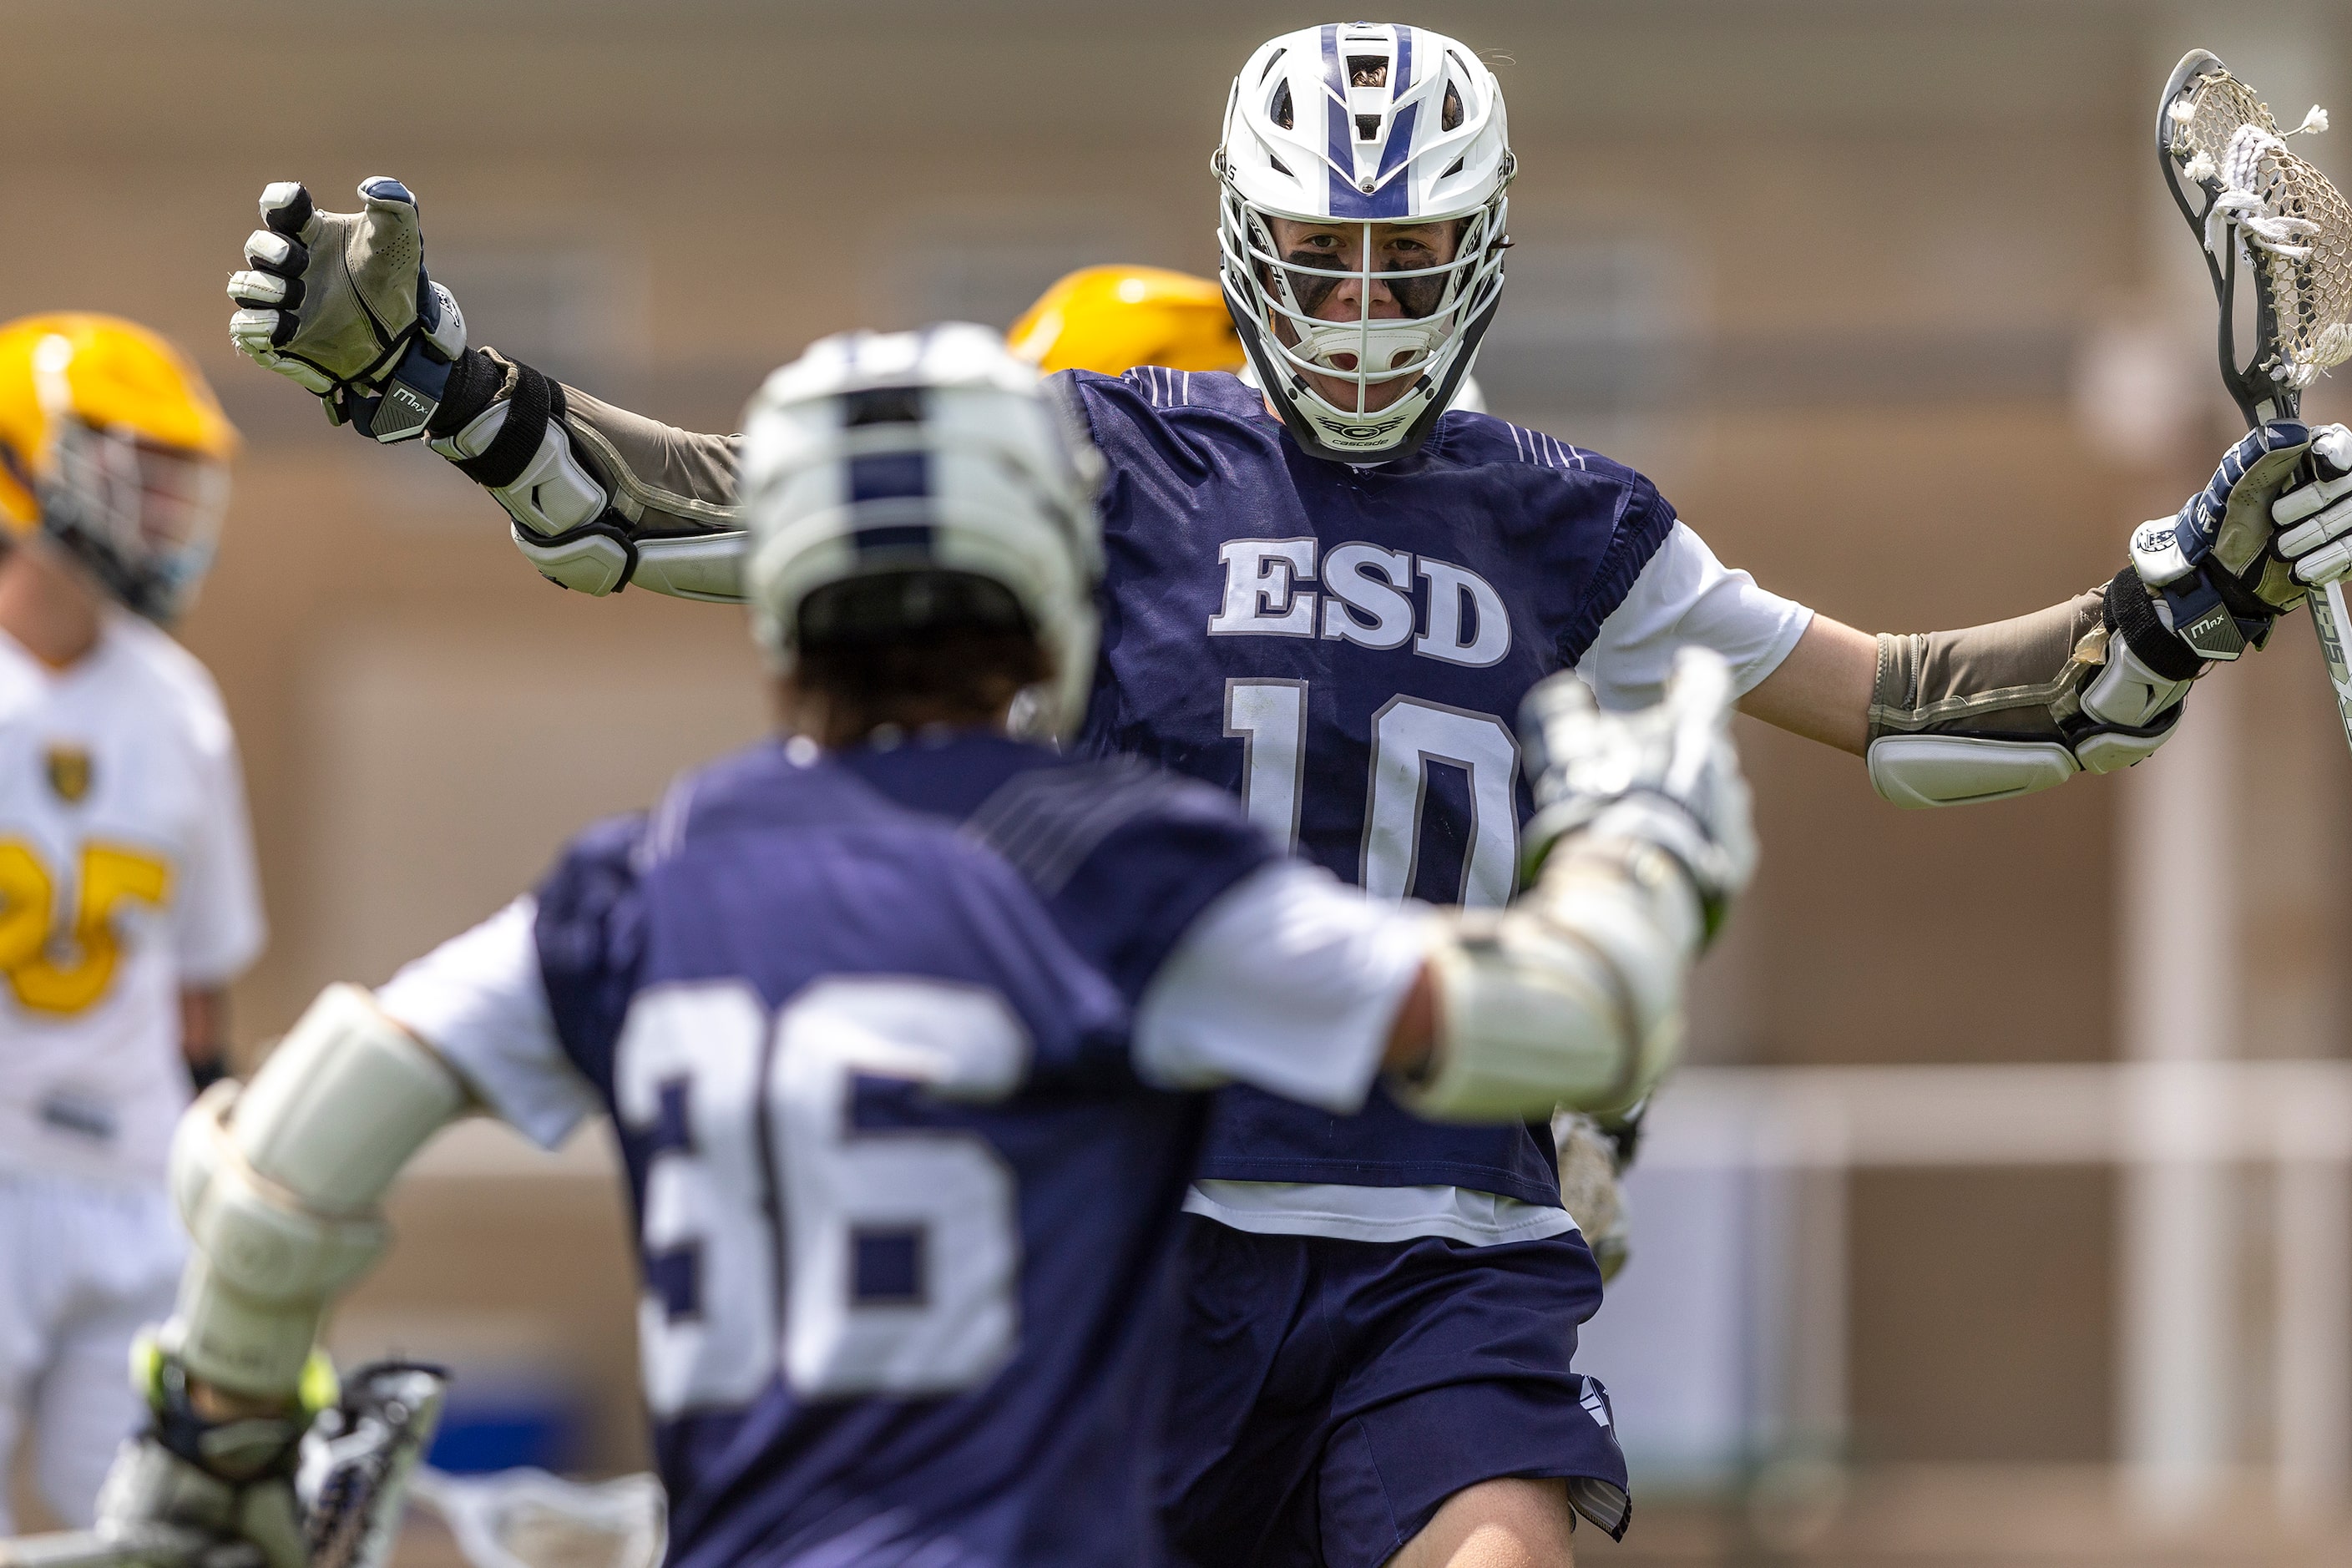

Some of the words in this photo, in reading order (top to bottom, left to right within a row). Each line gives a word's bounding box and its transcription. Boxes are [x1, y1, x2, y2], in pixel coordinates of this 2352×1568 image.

[1332, 438, 1388, 447] cascade
[2197, 503, 2217, 534] 10
[1207, 537, 1512, 668] ESD
[1222, 677, 1521, 915] 10
[614, 974, 1034, 1421] 36
